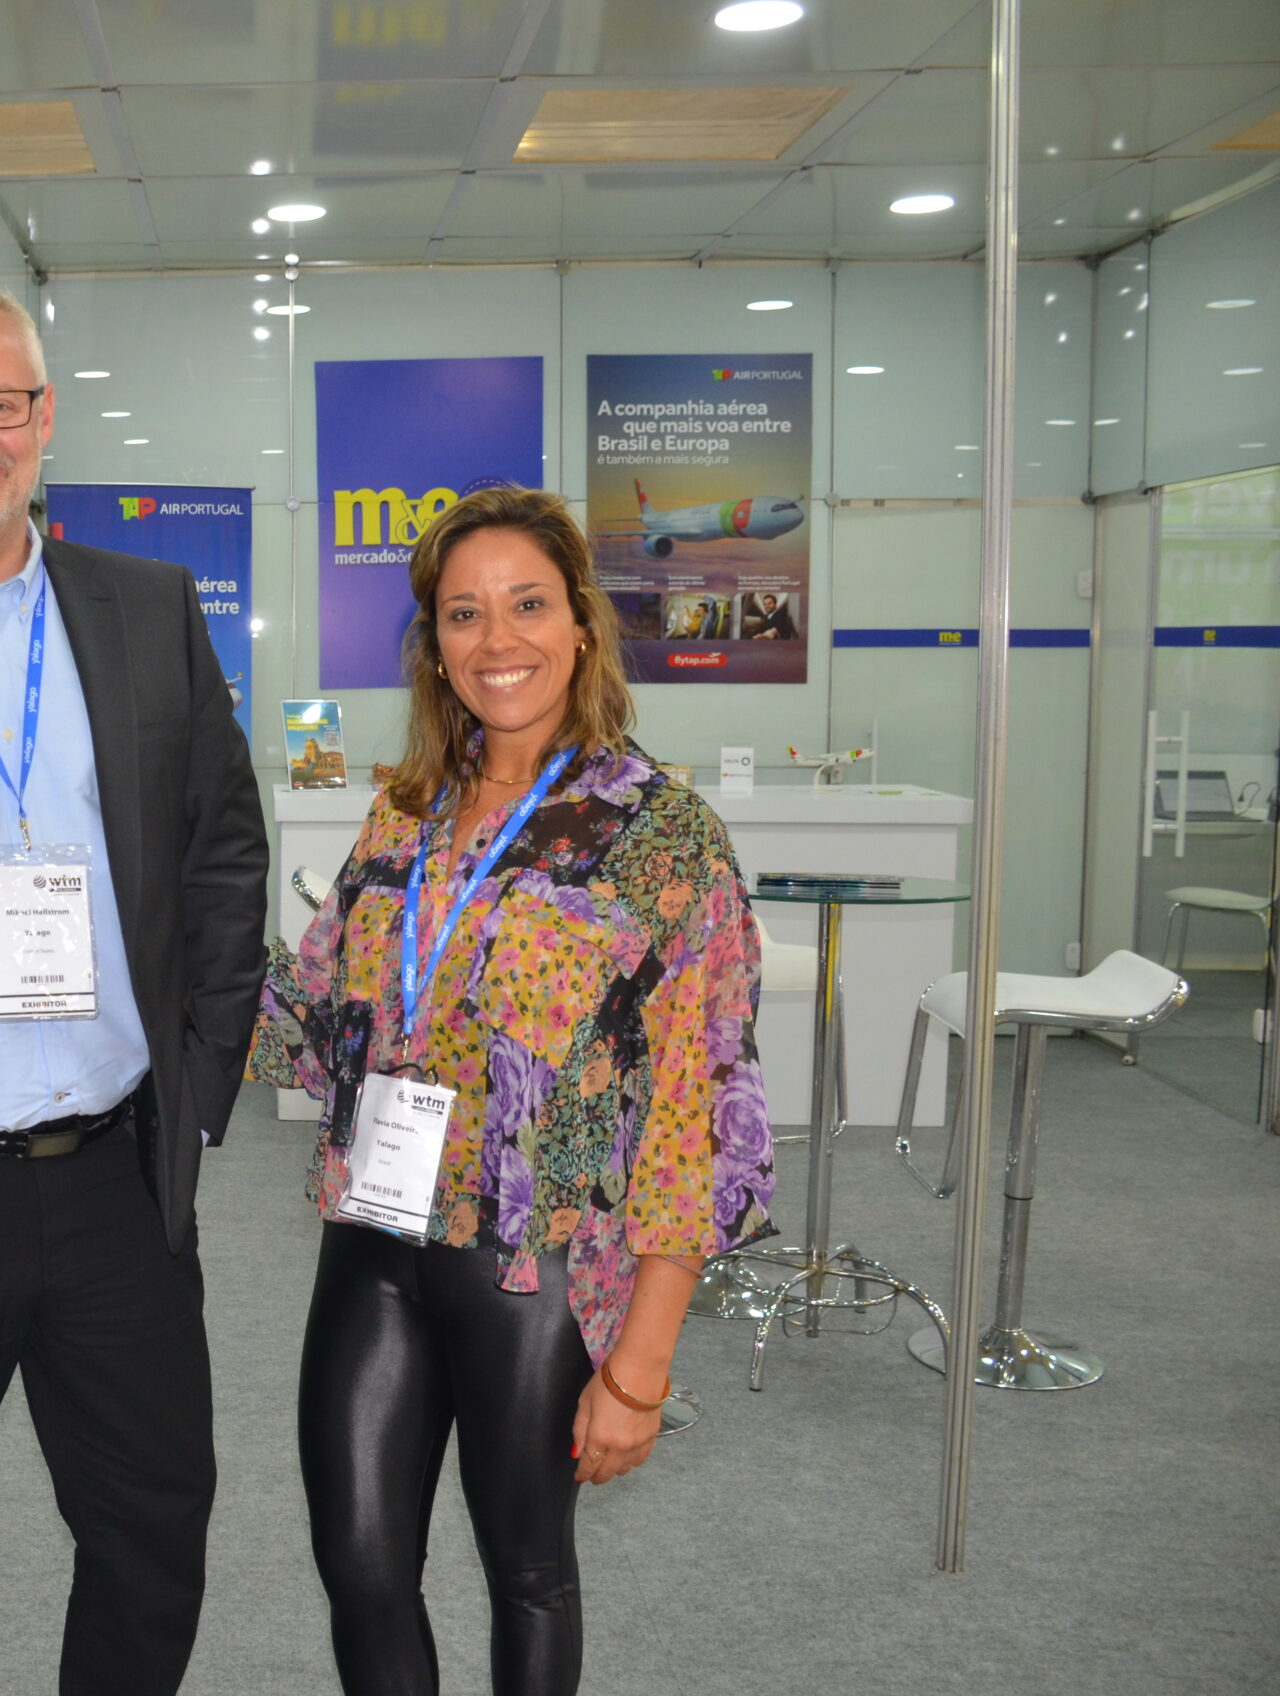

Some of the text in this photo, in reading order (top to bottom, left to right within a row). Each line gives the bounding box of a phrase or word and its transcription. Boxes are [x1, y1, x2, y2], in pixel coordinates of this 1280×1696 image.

[597, 399, 769, 420] A companhia aérea
[623, 418, 793, 437] que mais voa entre
[597, 435, 730, 455] Brasil e Europa
[597, 453, 730, 467] é também a mais segura
[119, 497, 157, 520] TAP
[674, 655, 720, 665] flytap.com
[28, 686, 37, 713] yalago
[519, 792, 539, 818] yalago
[488, 835, 508, 859] yalago
[49, 874, 81, 887] wtm
[405, 911, 414, 939] yalago
[405, 963, 414, 992] yalago
[413, 1093, 445, 1110] wtm
[357, 1206, 398, 1222] EXHIBITOR
